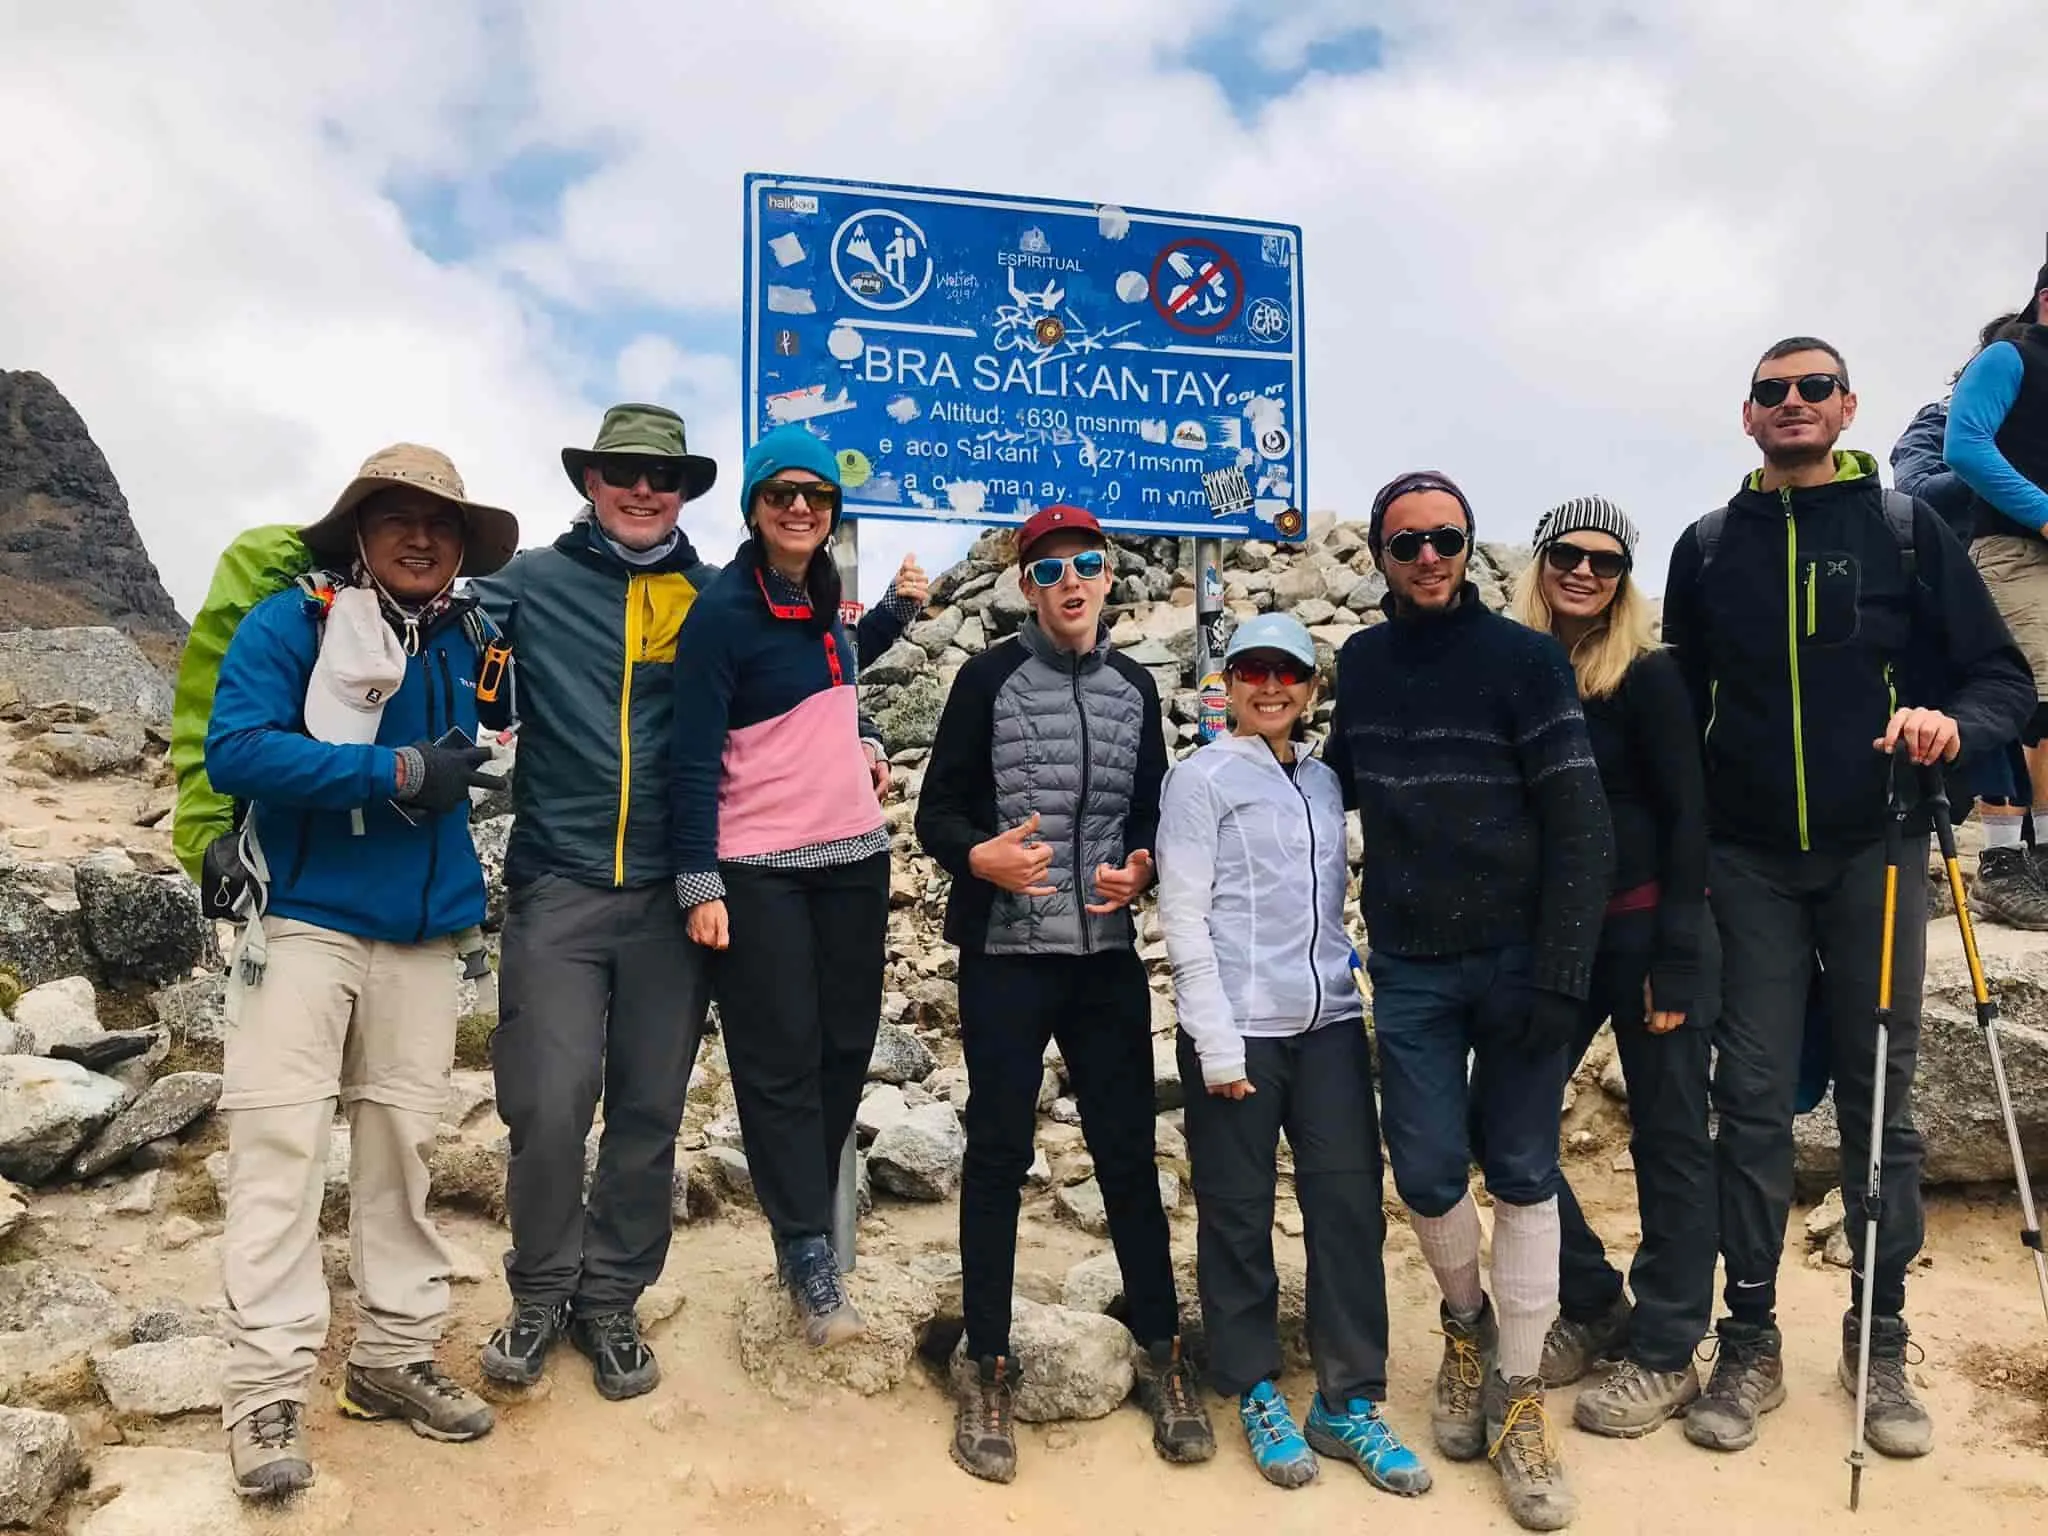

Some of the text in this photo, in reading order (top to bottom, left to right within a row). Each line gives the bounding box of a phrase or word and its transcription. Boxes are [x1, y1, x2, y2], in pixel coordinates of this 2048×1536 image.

[998, 252, 1085, 272] ESPIRITUAL
[840, 345, 961, 389] BRA
[929, 400, 1005, 425] Altitud:
[1016, 407, 1068, 430] 630
